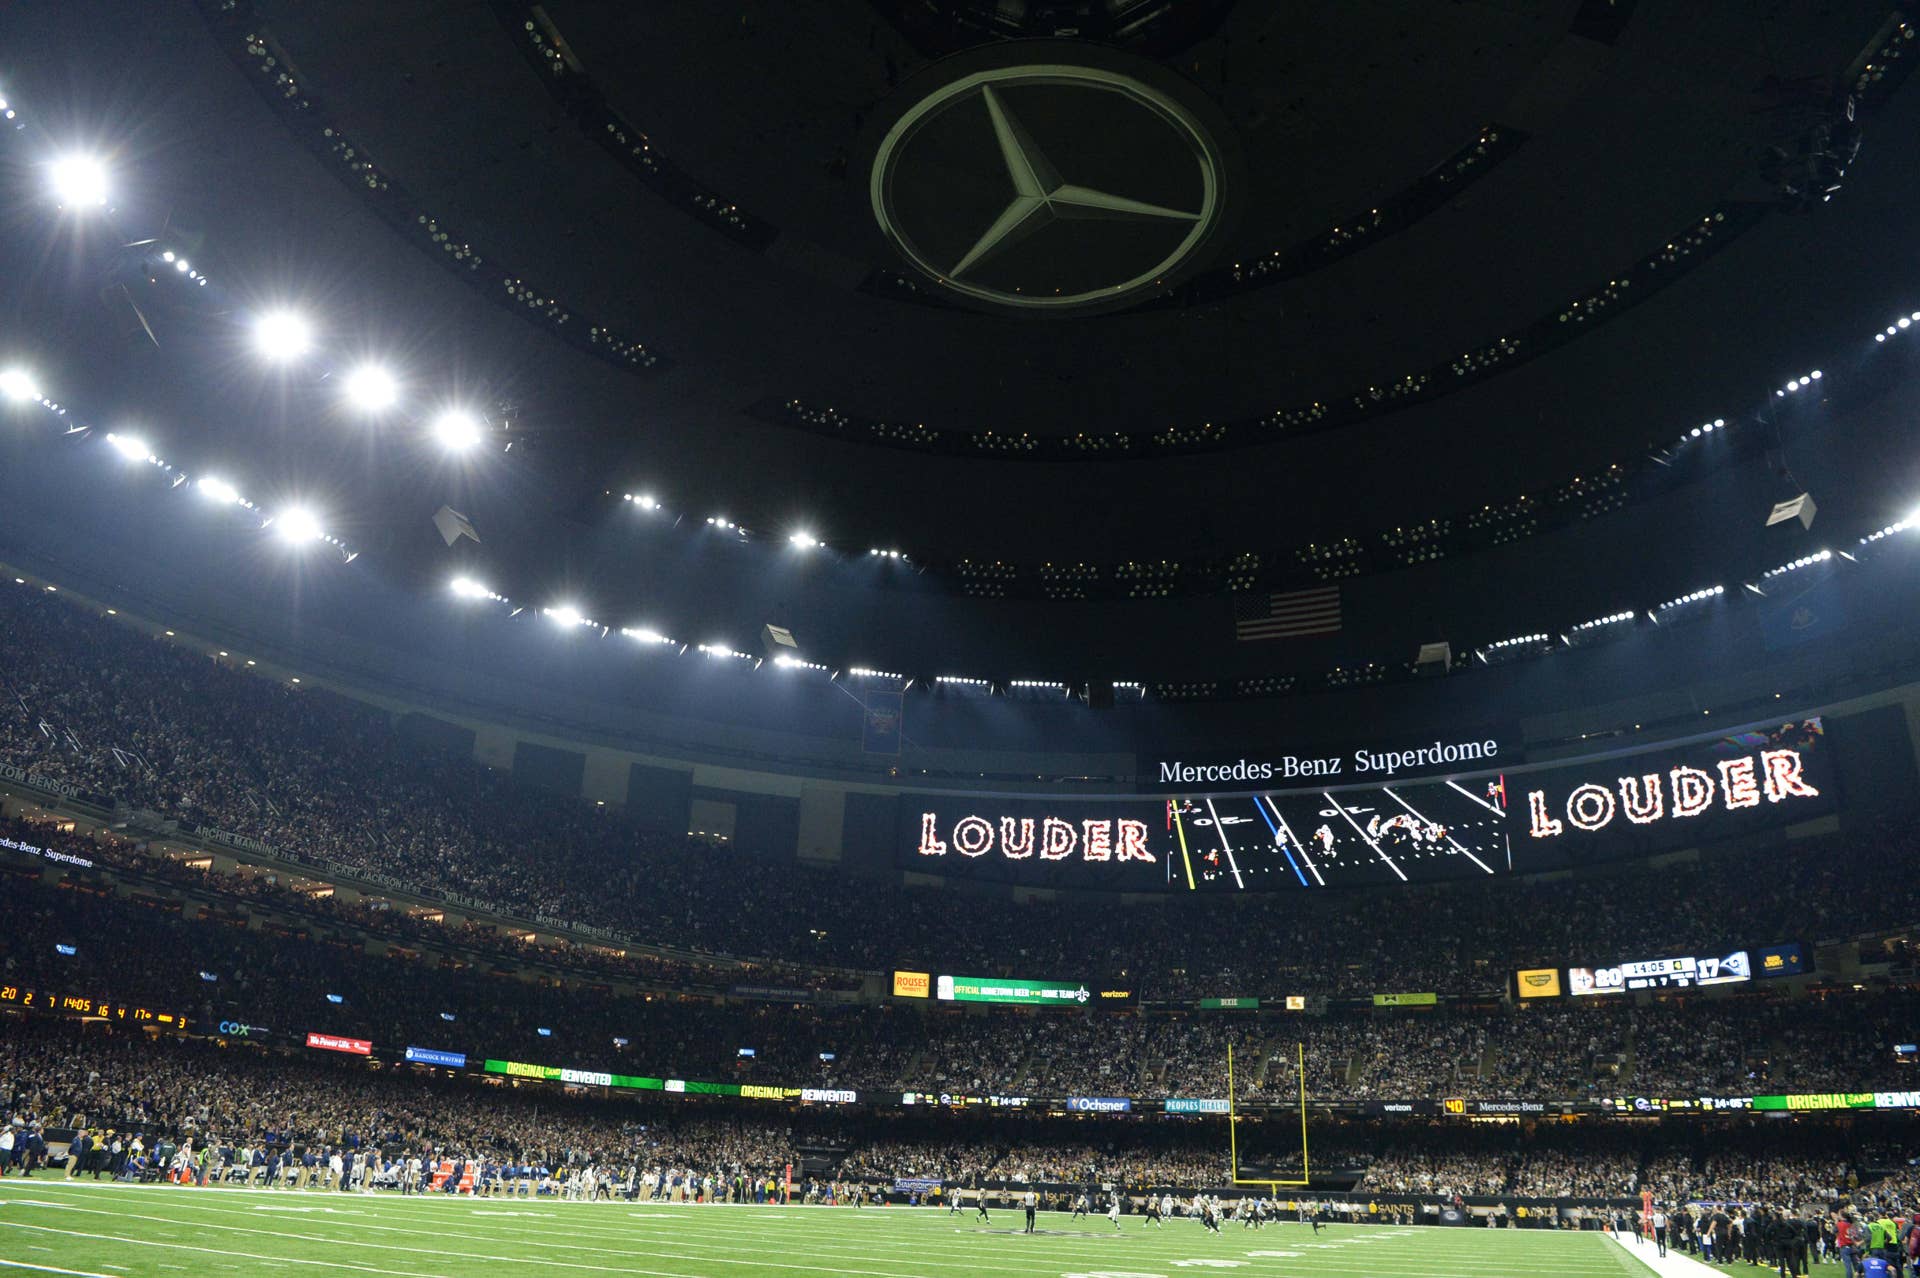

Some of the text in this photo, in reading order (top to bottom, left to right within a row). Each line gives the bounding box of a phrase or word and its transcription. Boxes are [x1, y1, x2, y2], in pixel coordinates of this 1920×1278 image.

[1160, 740, 1497, 783] Mercedes-Benz Superdome
[28, 774, 79, 797] BENSON
[1528, 749, 1819, 838] LOUDER
[194, 825, 232, 845] ARCHIE
[233, 836, 279, 856] MANNING
[918, 812, 1156, 863] LOUDER
[44, 848, 93, 868] Superdome
[361, 870, 402, 889] JACKSON
[535, 914, 568, 929] MORTEN
[1633, 961, 1665, 974] 14:05
[1697, 958, 1719, 978] 17
[896, 977, 927, 988] ROUSES
[1, 986, 17, 1001] 20
[23, 992, 33, 1006] 2
[955, 986, 979, 995] OFFICIAL
[1059, 990, 1074, 999] TEAM
[1101, 990, 1128, 998] verizon
[48, 996, 56, 1009] 7
[63, 997, 92, 1012] 14:05
[1220, 998, 1238, 1006] DIXIE
[98, 1005, 109, 1017] 16
[117, 1008, 126, 1019] 4
[134, 1009, 146, 1020] 17
[178, 1017, 187, 1029] 3
[309, 1035, 320, 1045] We
[320, 1037, 338, 1047] Power
[414, 1052, 439, 1061] HANCOCK
[506, 1061, 546, 1079] ORIGINAL
[561, 1069, 612, 1085] REINVENTED
[740, 1085, 857, 1103] ORIGINAL AND REINVENTED
[1000, 1097, 1021, 1106] 14:05
[1079, 1098, 1125, 1111] Ochsner
[1166, 1100, 1229, 1111] PEOPLES HEALTH
[1445, 1101, 1463, 1114] 40
[1479, 1101, 1544, 1112] Mercedes-Benz
[1714, 1098, 1743, 1108] 14:05
[1786, 1093, 1851, 1109] ORIGINAL
[1854, 1093, 1873, 1104] AND
[1384, 1104, 1411, 1112] verizon
[1378, 1203, 1415, 1214] SAINTS
